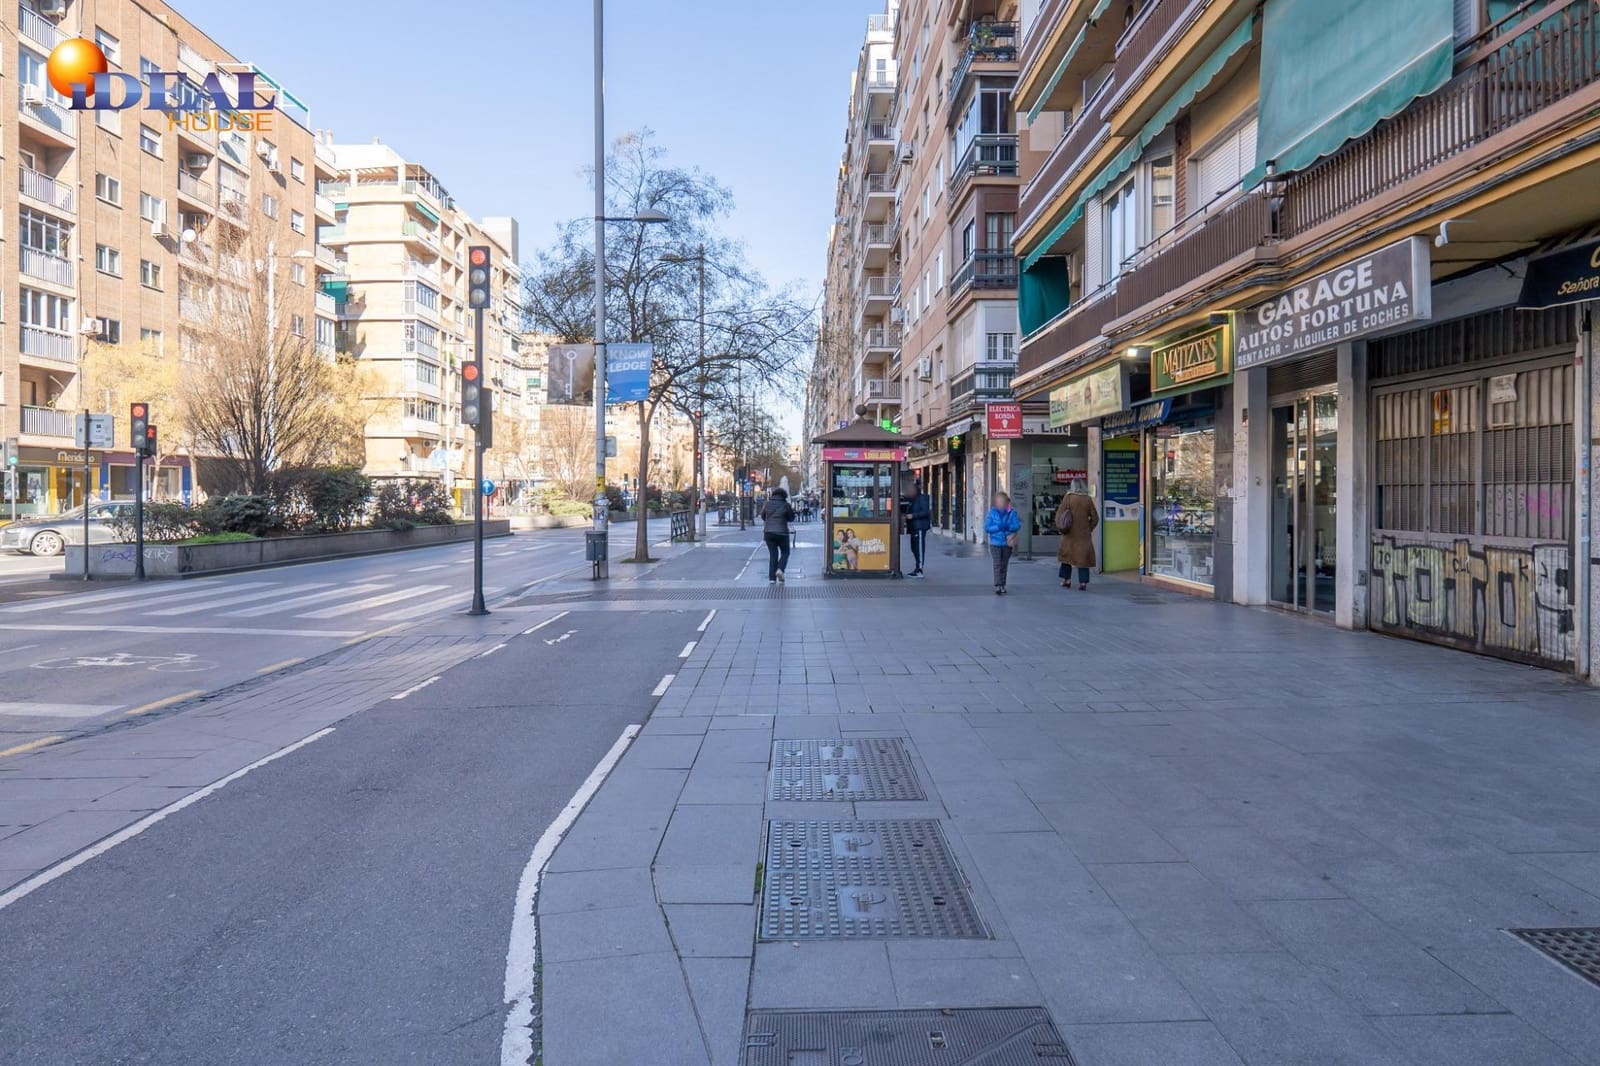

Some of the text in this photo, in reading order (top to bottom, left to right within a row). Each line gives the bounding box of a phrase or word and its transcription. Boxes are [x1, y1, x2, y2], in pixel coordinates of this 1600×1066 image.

[1257, 259, 1373, 326] GARAGE
[1238, 280, 1408, 353] AUTOS FORTUNA
[1293, 326, 1339, 350] ALQUILER
[1343, 321, 1357, 335] DE
[1362, 303, 1409, 328] COCHES
[610, 350, 649, 360] KNOW
[610, 361, 648, 373] LEDGE
[989, 405, 1020, 413] ELECTRICA
